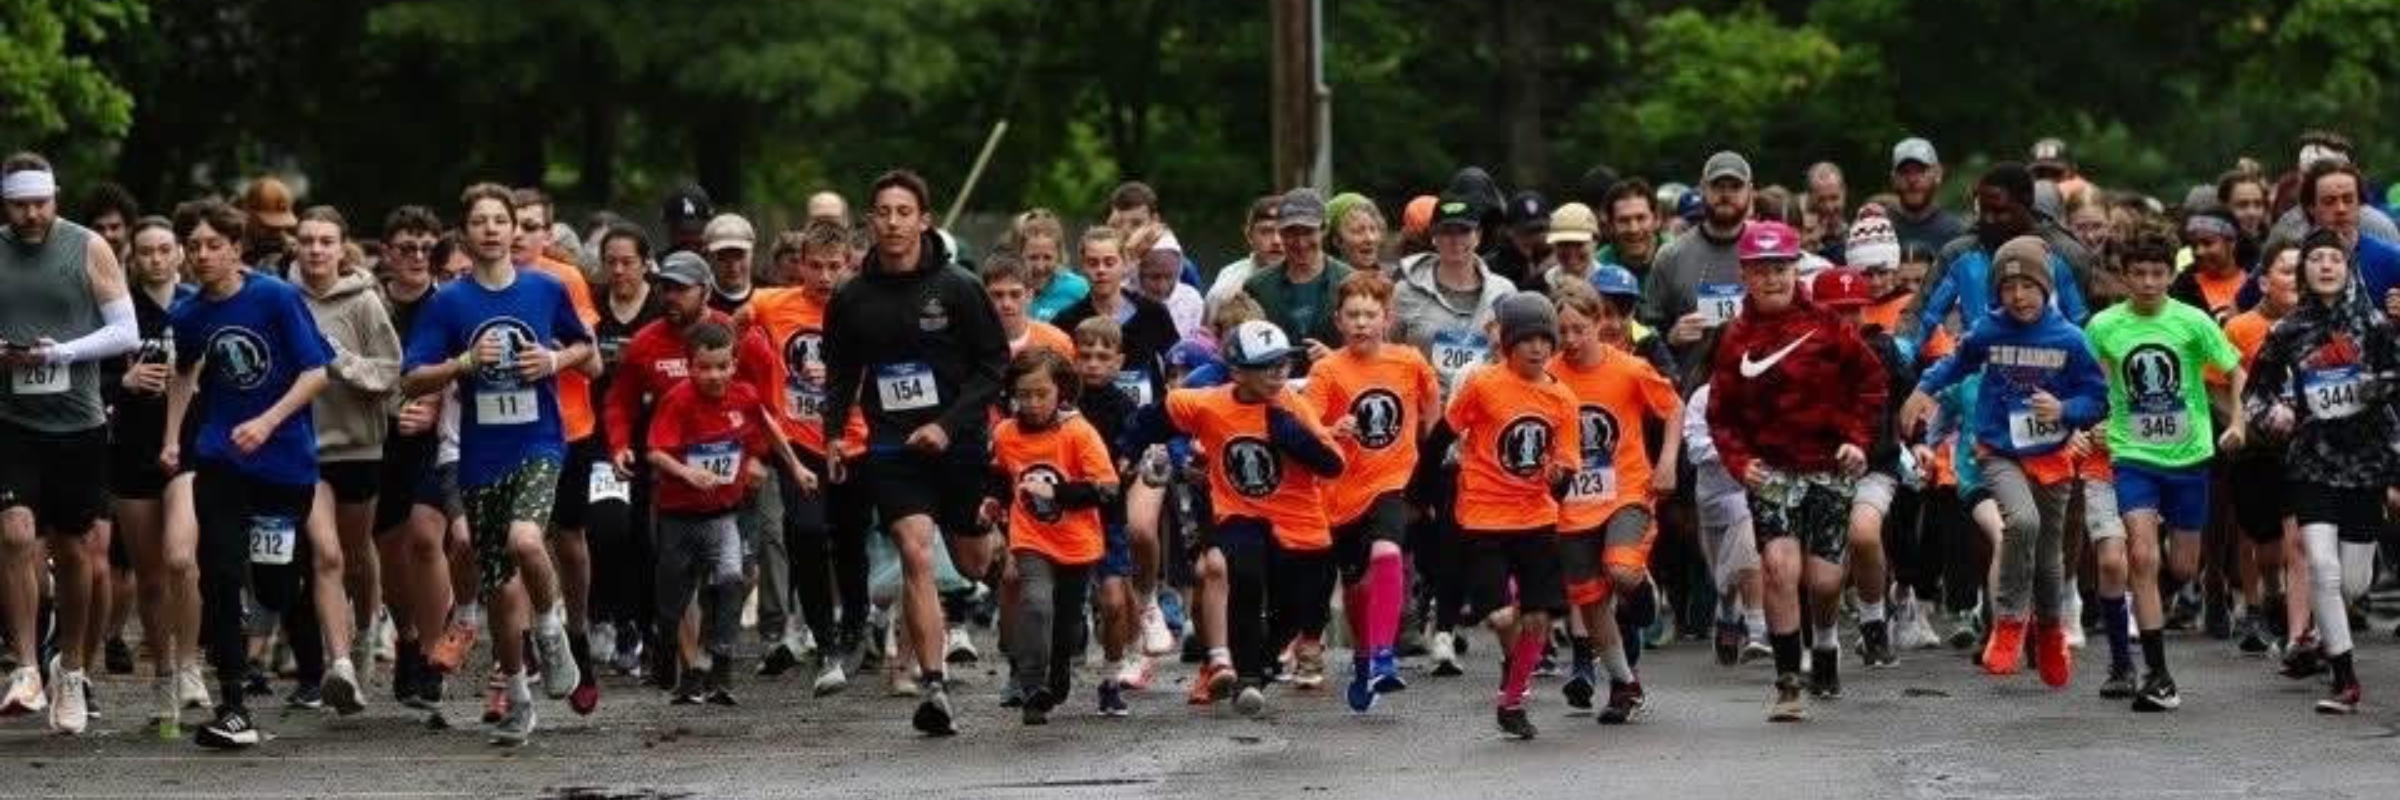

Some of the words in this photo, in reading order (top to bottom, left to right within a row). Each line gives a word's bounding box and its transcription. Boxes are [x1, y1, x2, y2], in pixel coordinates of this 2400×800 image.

[1717, 300, 1735, 319] 13
[892, 378, 923, 401] 154
[2318, 383, 2354, 410] 344
[497, 395, 517, 416] 11
[2141, 415, 2176, 437] 346
[1570, 473, 1603, 497] 123
[252, 529, 283, 555] 212
